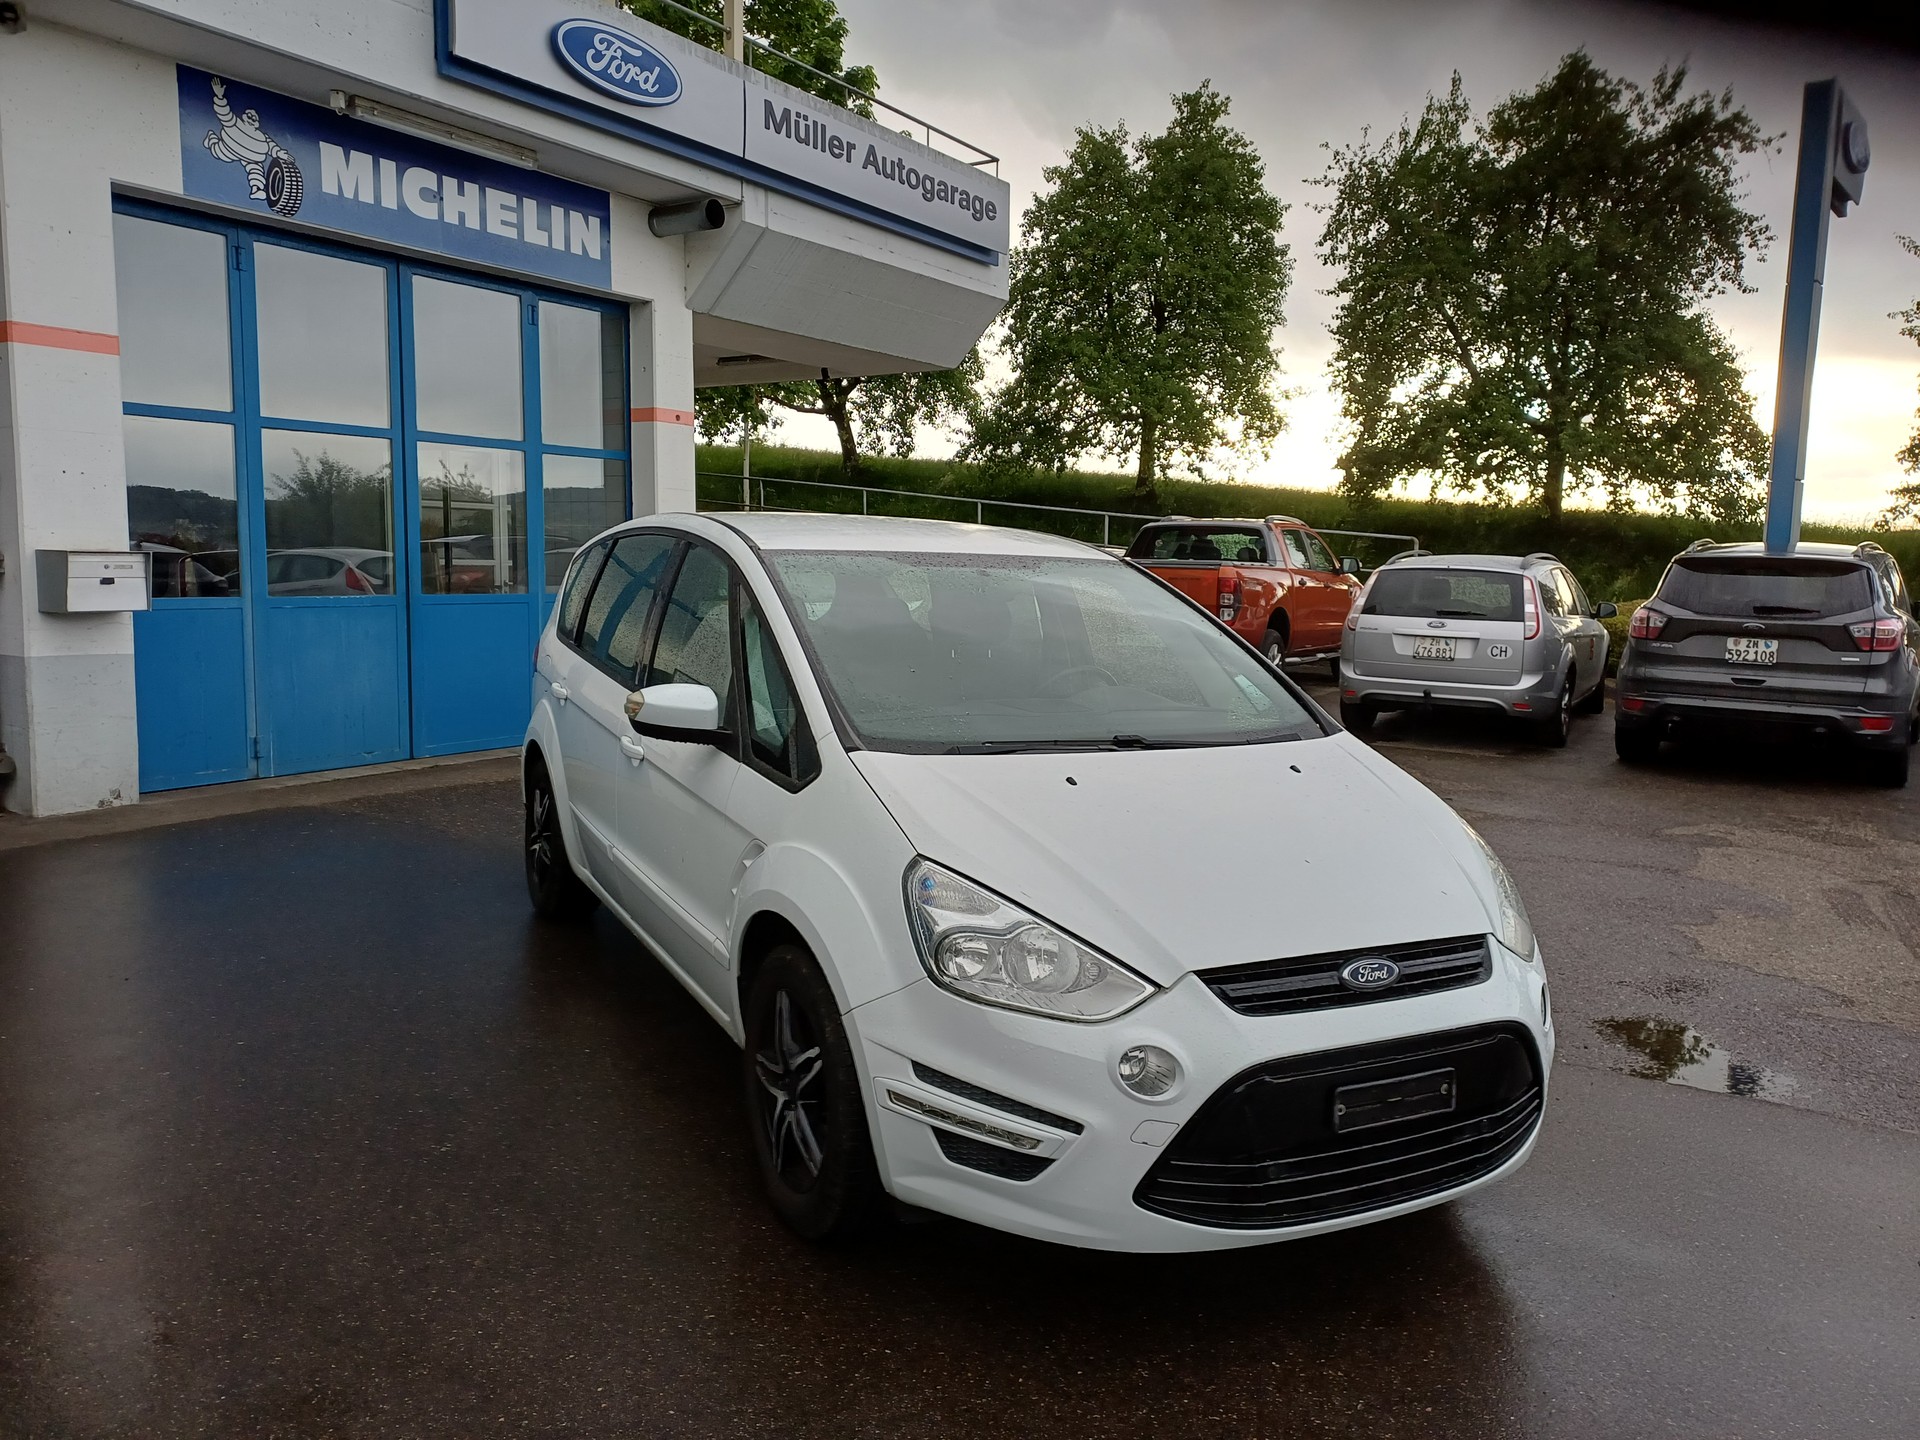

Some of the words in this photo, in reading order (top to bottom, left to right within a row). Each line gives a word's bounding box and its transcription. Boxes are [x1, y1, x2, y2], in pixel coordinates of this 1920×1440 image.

[586, 33, 660, 93] Ford
[764, 99, 856, 163] Müller
[862, 144, 997, 221] Autogarage
[319, 141, 601, 260] MICHELIN
[1430, 638, 1441, 646] ZH
[1746, 640, 1759, 649] ZH
[1490, 645, 1508, 658] CH
[1727, 649, 1750, 661] 592
[1753, 650, 1775, 662] 108
[1358, 964, 1389, 982] Ford
